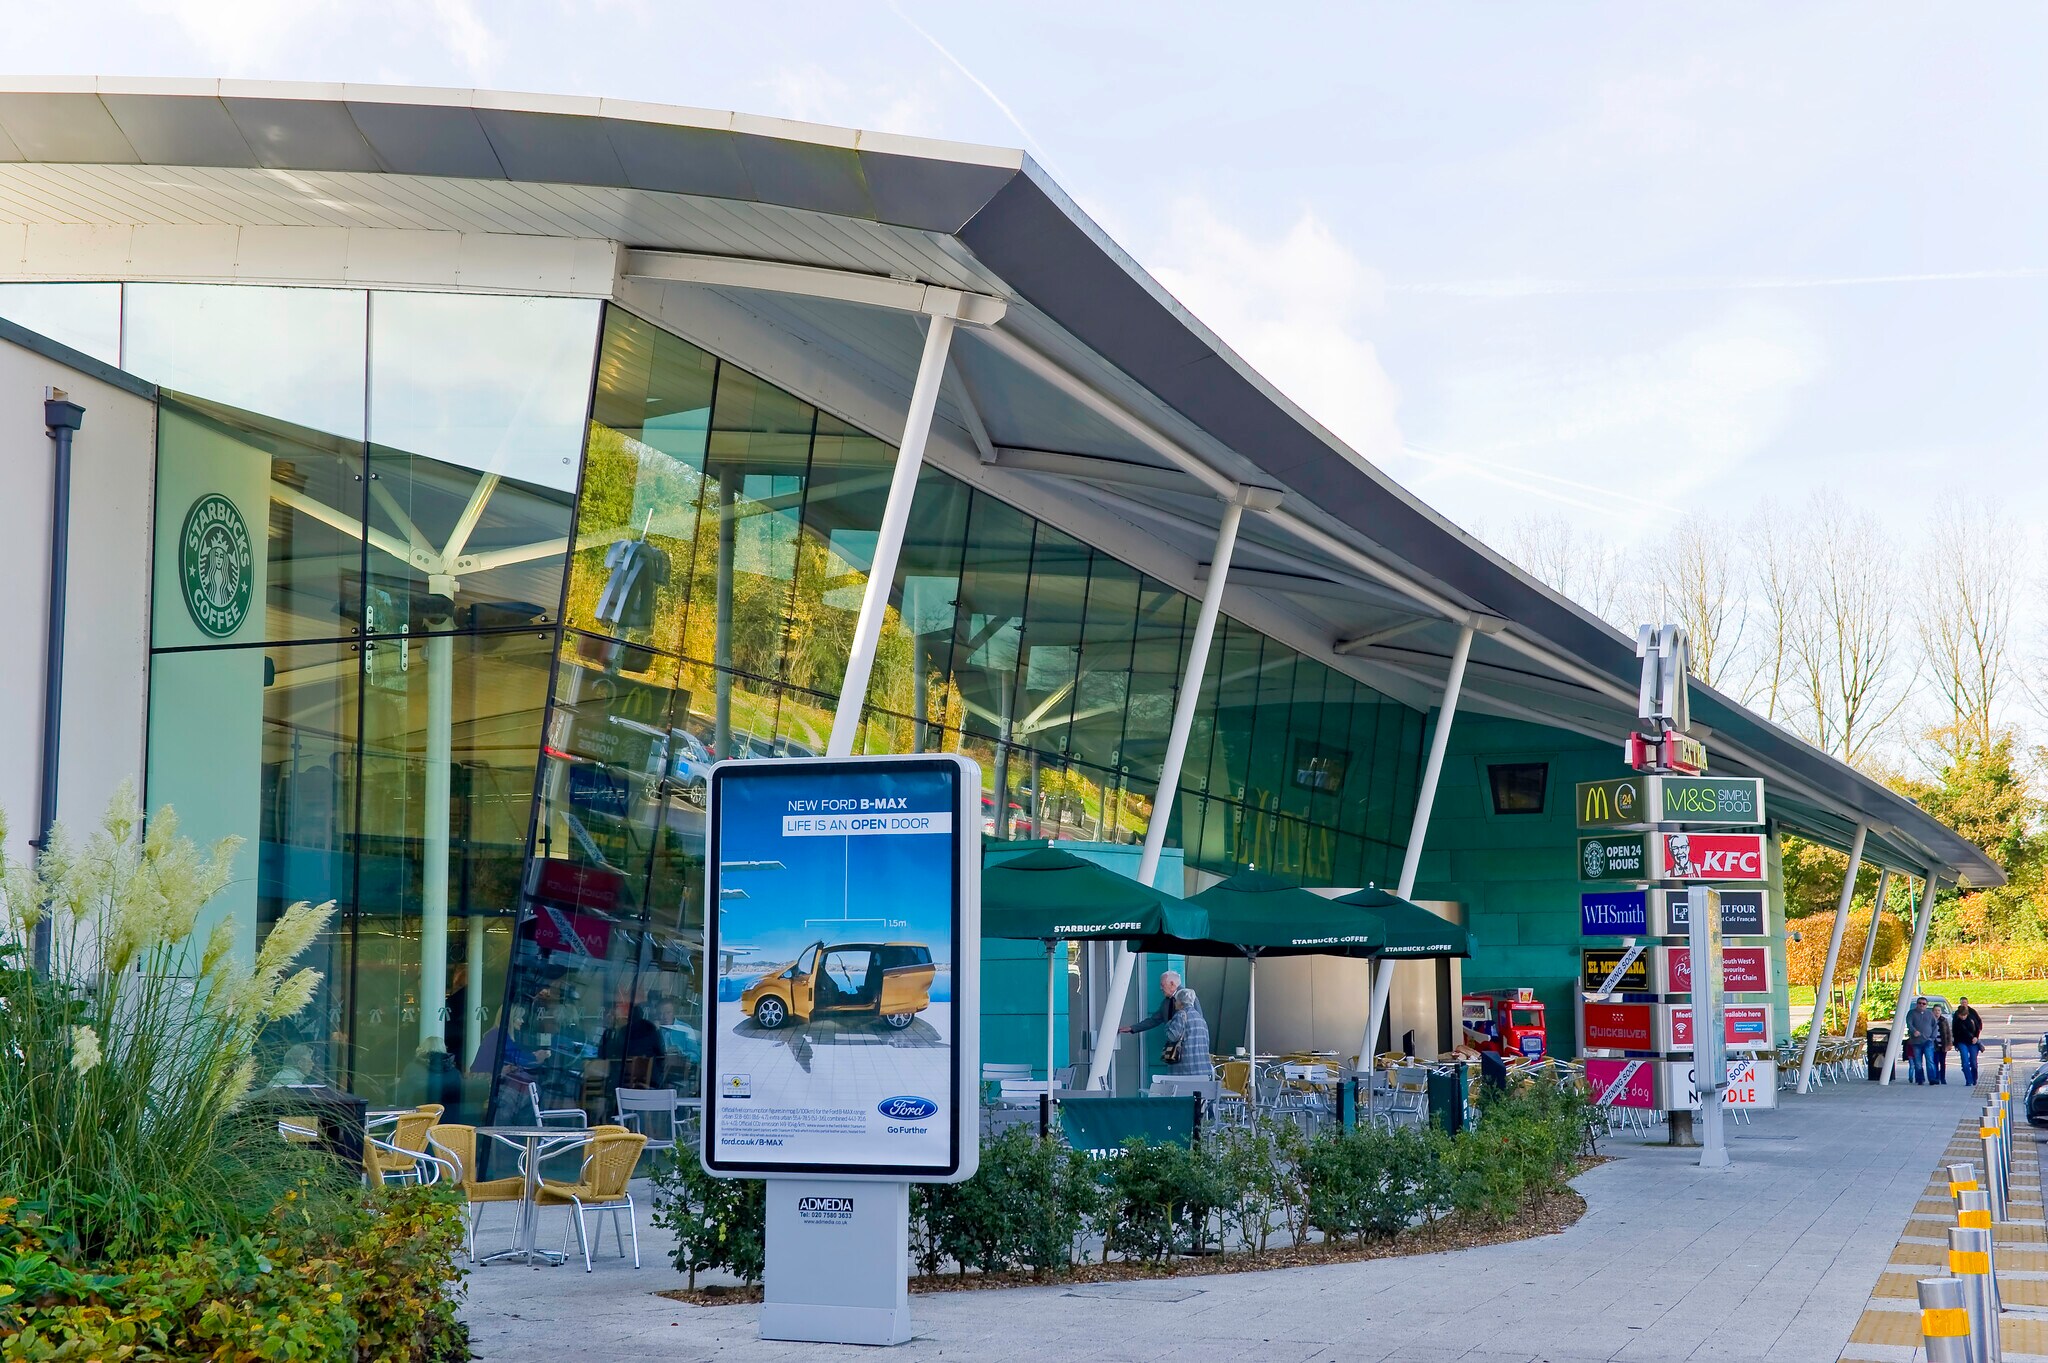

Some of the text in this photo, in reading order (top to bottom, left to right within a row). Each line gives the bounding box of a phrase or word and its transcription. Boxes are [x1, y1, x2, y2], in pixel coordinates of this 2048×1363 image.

[189, 502, 250, 568] STARBUCKS
[194, 588, 241, 630] COFFEE
[788, 798, 907, 812] NEW FORD B-MAX
[1622, 793, 1632, 805] 24
[1667, 787, 1752, 812] M&S SIMPLY
[1718, 801, 1752, 813] FOOD
[787, 817, 929, 831] LIFE IS AN OPEN DOOR
[1606, 844, 1641, 858] OPEN 24
[1609, 858, 1639, 870] HOURS
[1702, 850, 1758, 872] KFC
[1584, 903, 1645, 924] WHSmith
[1731, 904, 1756, 913] FOUR
[889, 919, 907, 927] 1.5m
[1053, 922, 1141, 933] STARBUCKS COFFEE
[1292, 937, 1339, 945] STARBUCKS
[1588, 960, 1645, 974] EL MEXANA
[1737, 957, 1755, 965] West's
[1725, 1010, 1747, 1018] vailable
[1729, 1058, 1751, 1081] SOON
[1601, 1061, 1637, 1106] OPENING SOON
[1631, 1083, 1649, 1102] dog
[1689, 1089, 1756, 1104] NDLE
[889, 1098, 926, 1117] Ford
[887, 1126, 928, 1135] Go Further
[721, 1137, 784, 1146] ford.co.uk/B-MAX
[800, 1198, 852, 1211] ADMEDIA
